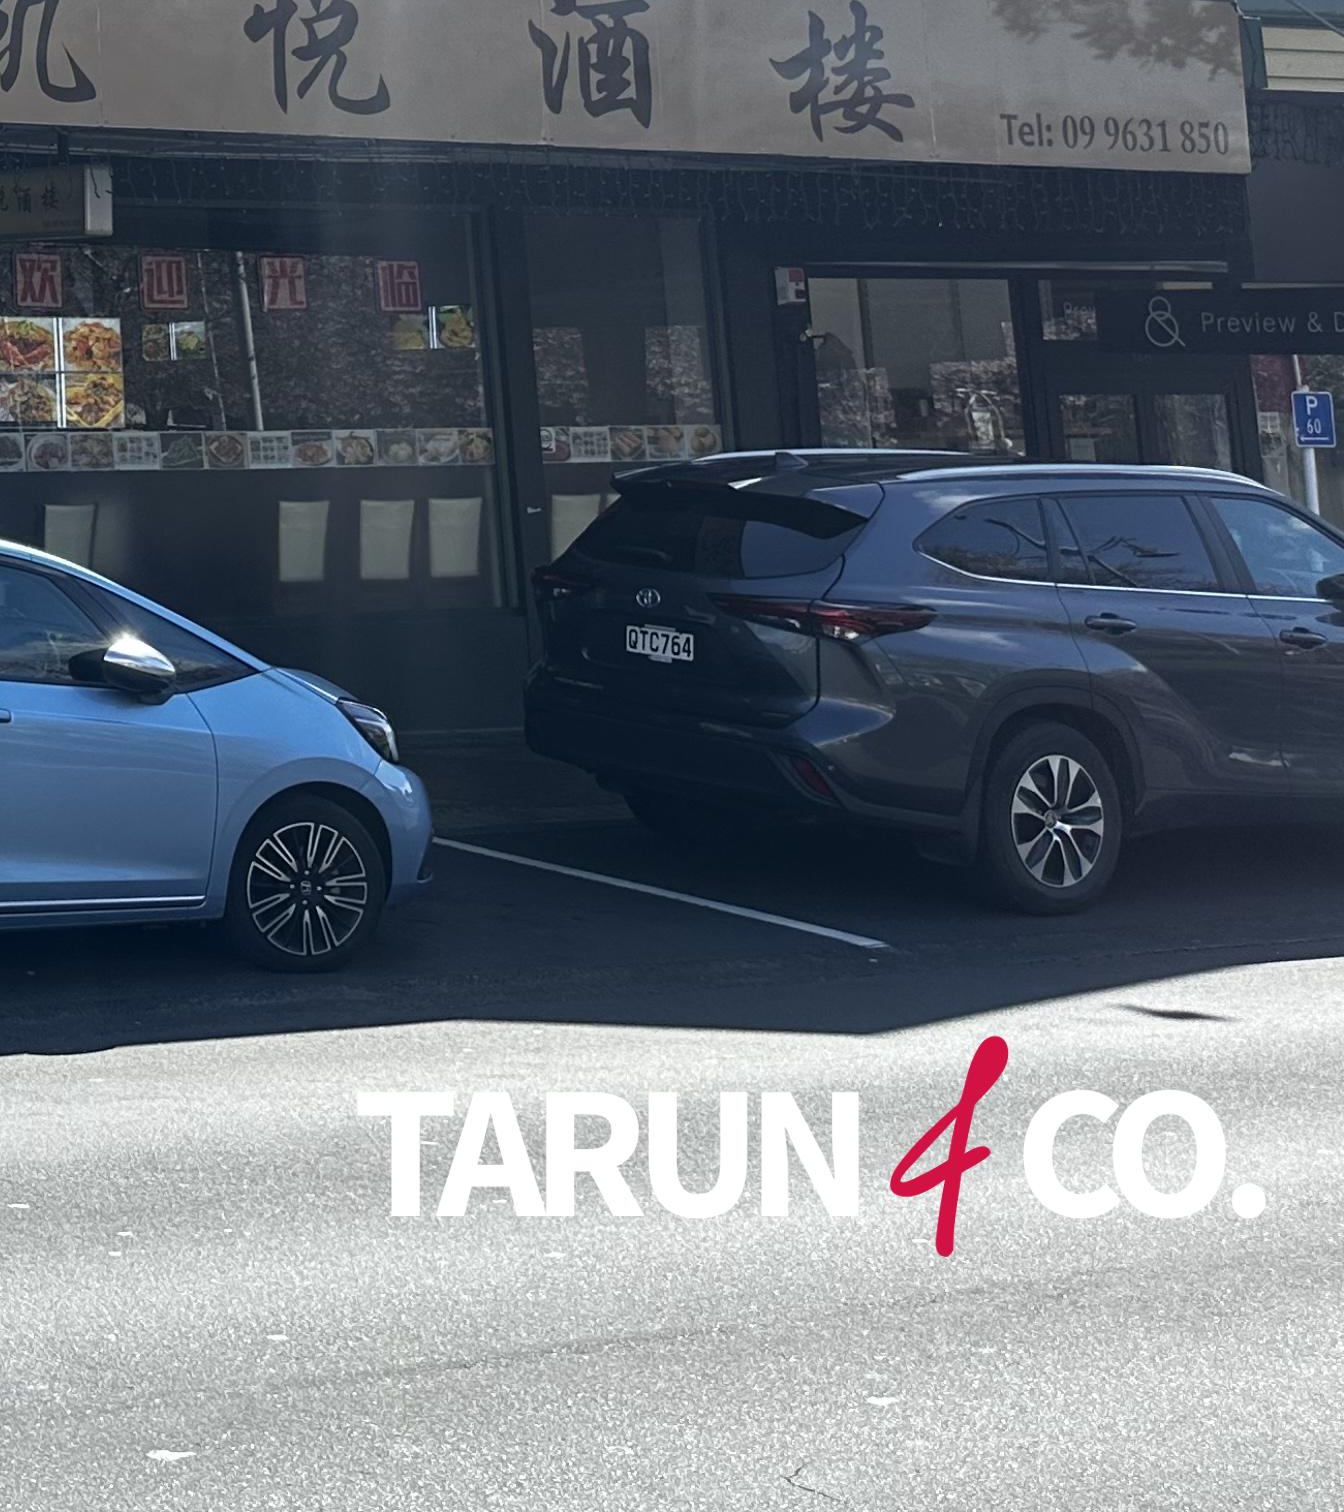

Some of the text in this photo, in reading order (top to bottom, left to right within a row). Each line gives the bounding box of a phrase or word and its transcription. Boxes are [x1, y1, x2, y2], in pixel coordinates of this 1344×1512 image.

[1000, 113, 1229, 155] Tel: 09 9631 850
[1201, 311, 1297, 334] Preview
[1307, 311, 1323, 333] &
[1305, 395, 1318, 415] P
[1307, 418, 1322, 434] 60
[628, 629, 692, 657] QTC764
